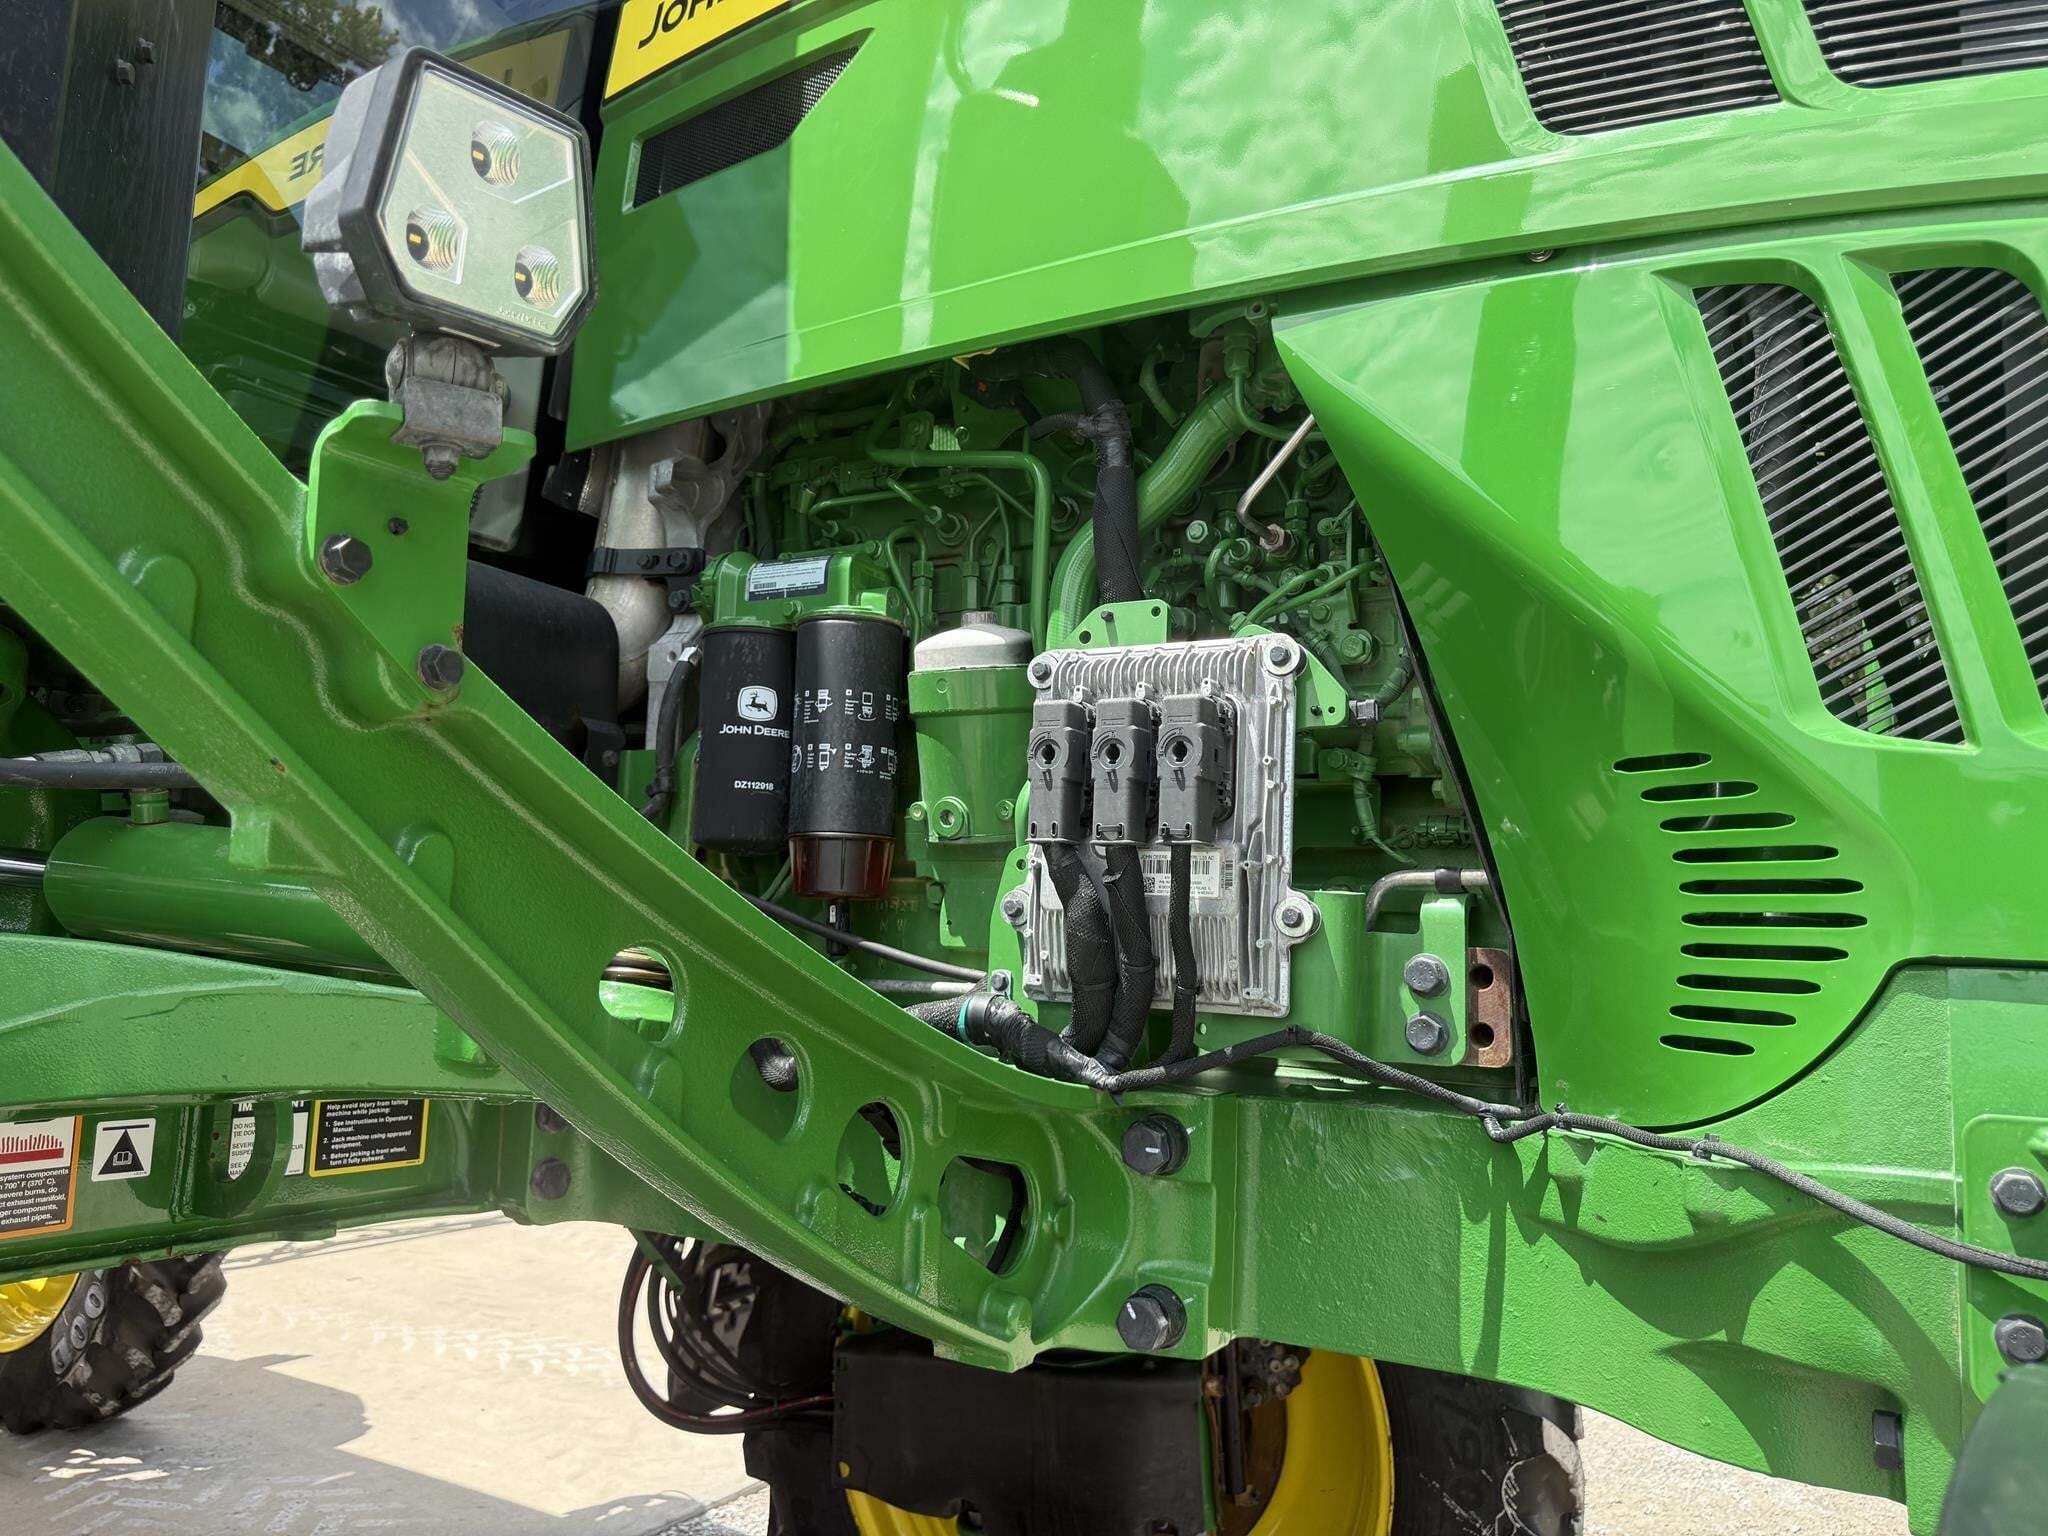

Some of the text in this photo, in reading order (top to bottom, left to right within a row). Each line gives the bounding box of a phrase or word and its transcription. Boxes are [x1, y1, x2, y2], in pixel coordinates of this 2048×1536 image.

[719, 724, 790, 738] JOHN DEERE
[26, 1168, 69, 1179] components
[0, 1191, 23, 1199] severe
[6, 1198, 34, 1207] exhaust
[35, 1194, 66, 1203] manifold,
[13, 1204, 58, 1215] components,
[1, 1213, 53, 1225] exhaust pipes.
